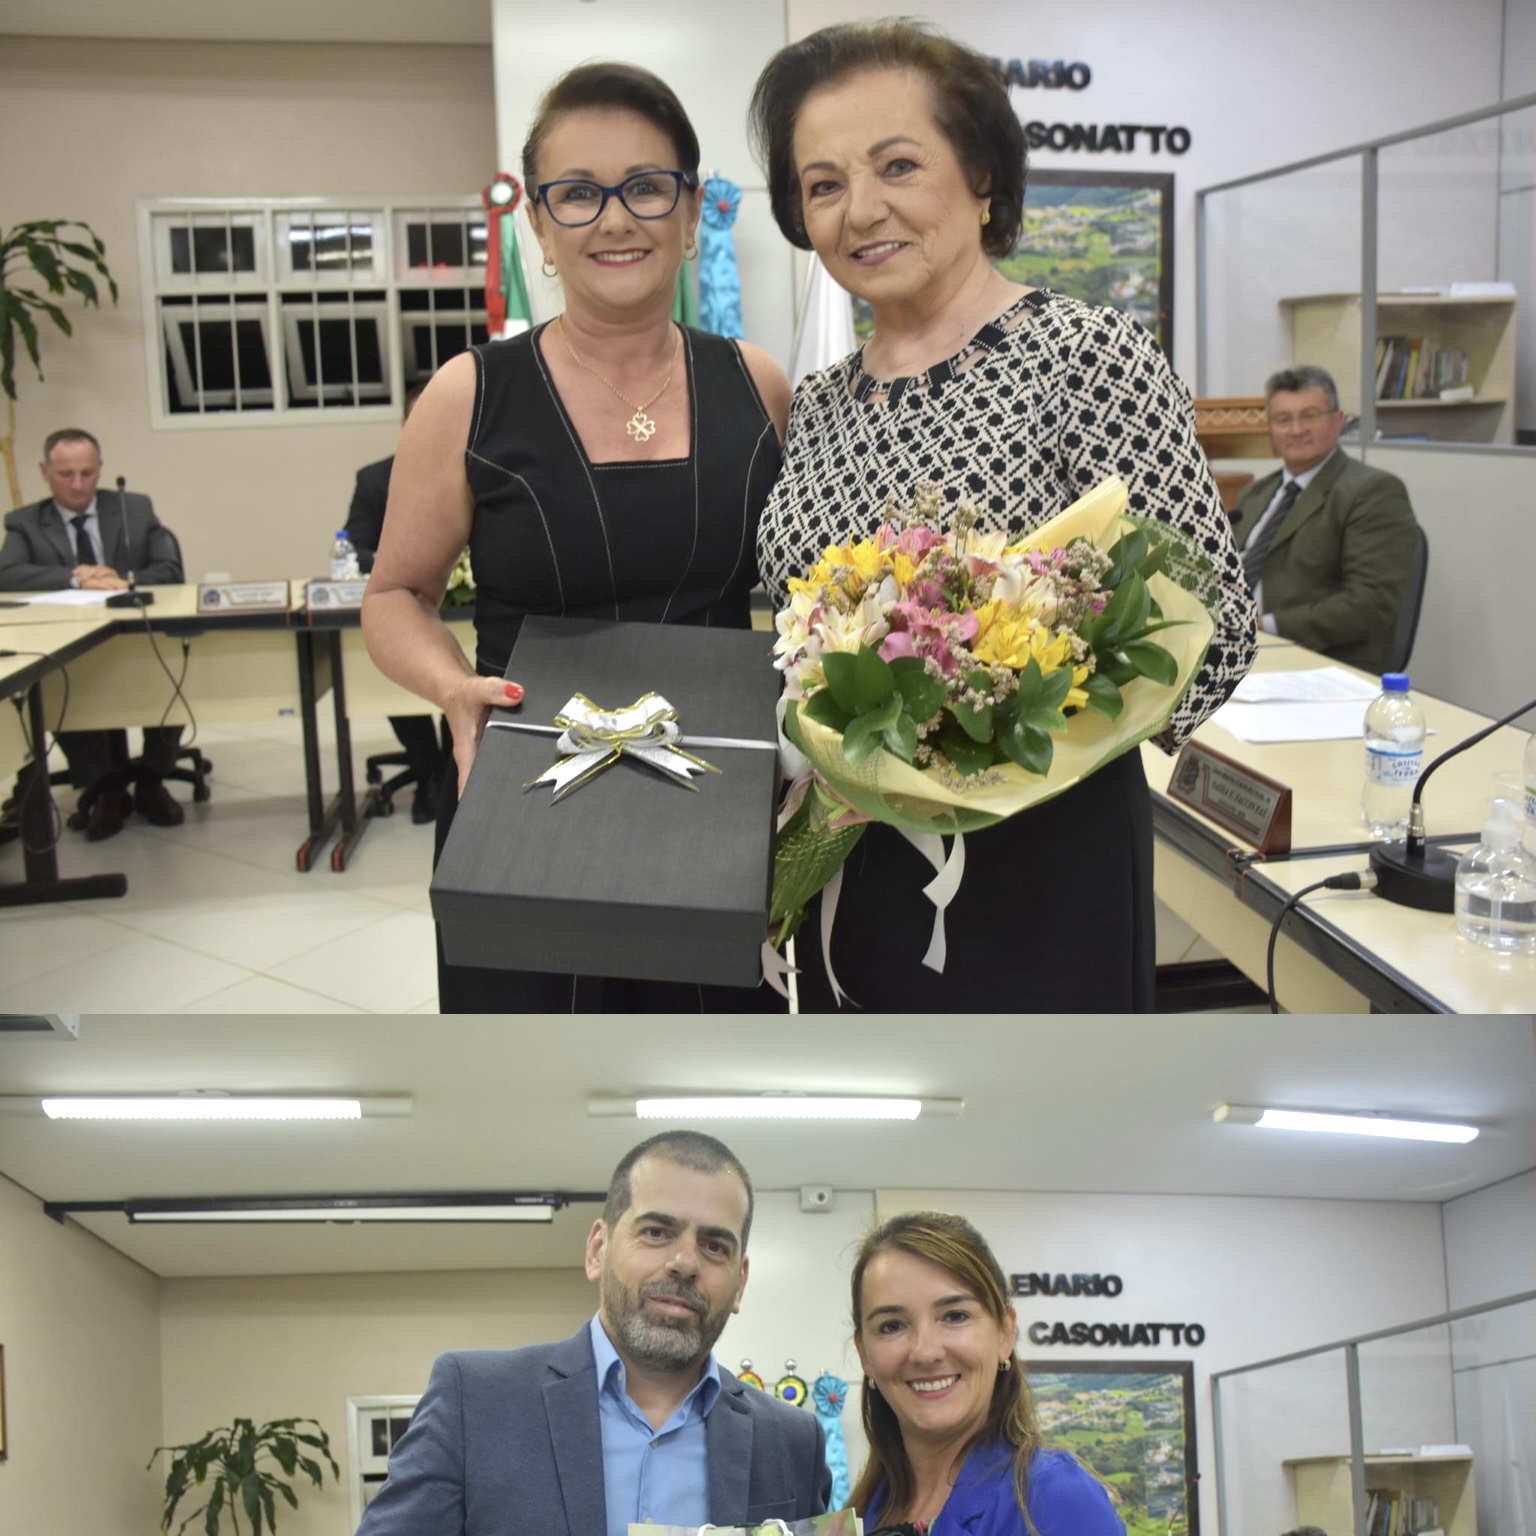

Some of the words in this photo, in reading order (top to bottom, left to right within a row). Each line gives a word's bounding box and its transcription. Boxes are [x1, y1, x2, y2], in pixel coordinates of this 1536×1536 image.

[995, 58, 1091, 90] ARIO
[1025, 121, 1191, 155] SONATTO
[1010, 1273, 1123, 1297] ENARIO
[1029, 1321, 1205, 1347] CASONATTO
